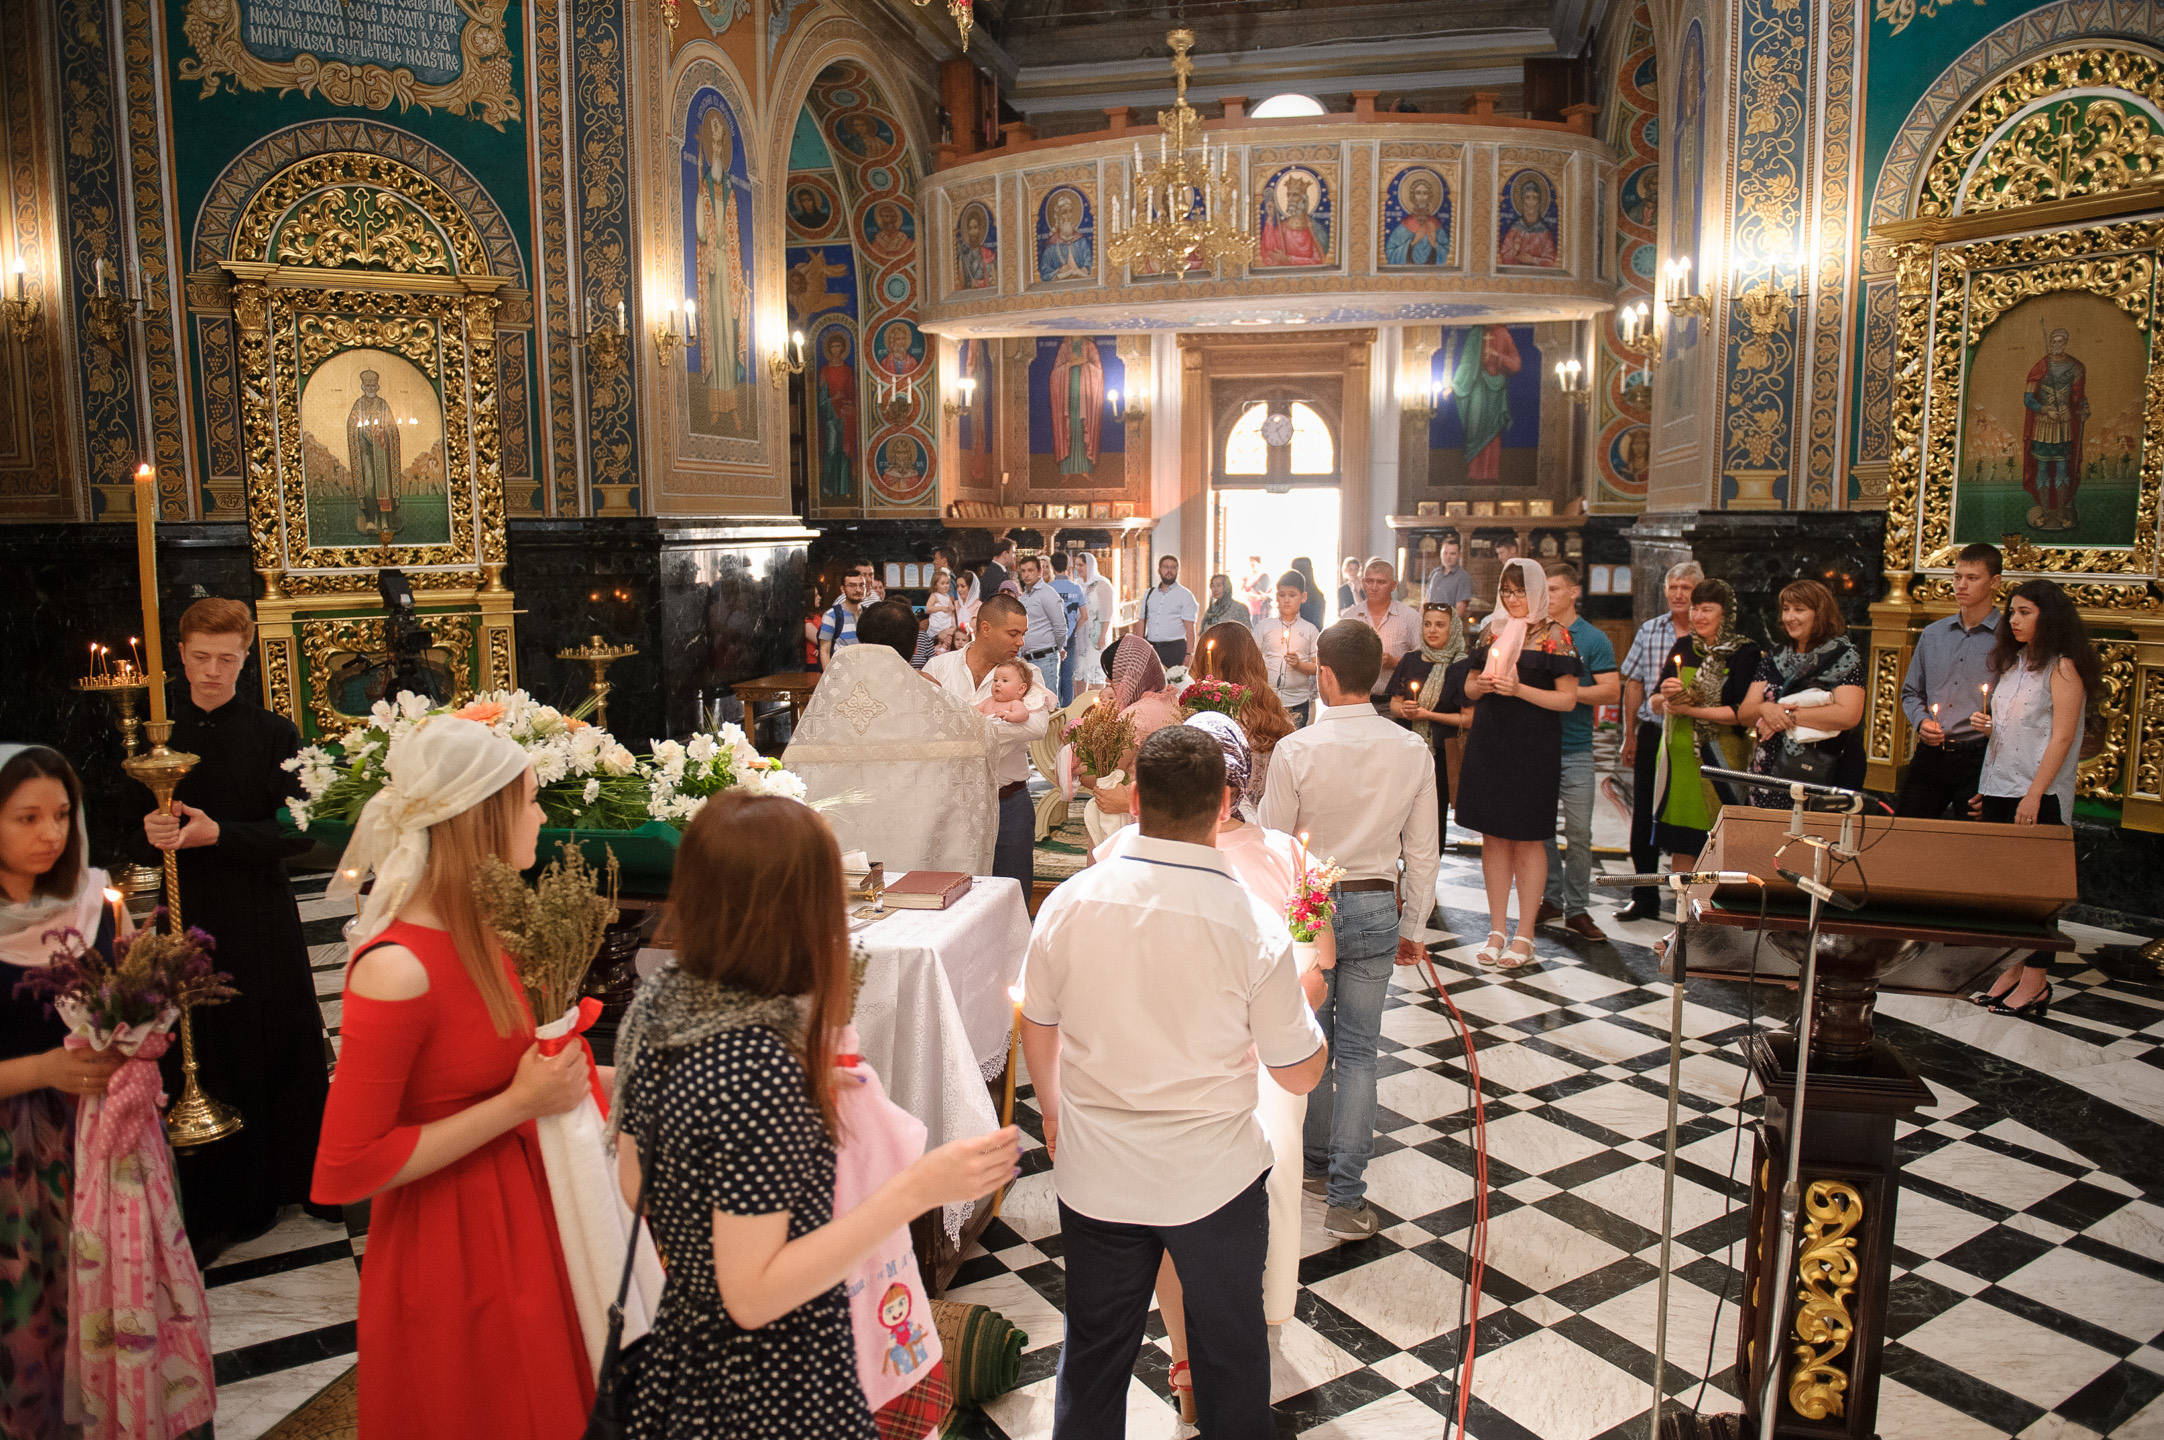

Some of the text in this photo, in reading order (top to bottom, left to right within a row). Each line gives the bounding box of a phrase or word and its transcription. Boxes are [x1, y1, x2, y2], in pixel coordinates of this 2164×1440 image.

[347, 2, 378, 21] CELE
[349, 20, 364, 39] PE
[367, 23, 418, 47] HRISTOS
